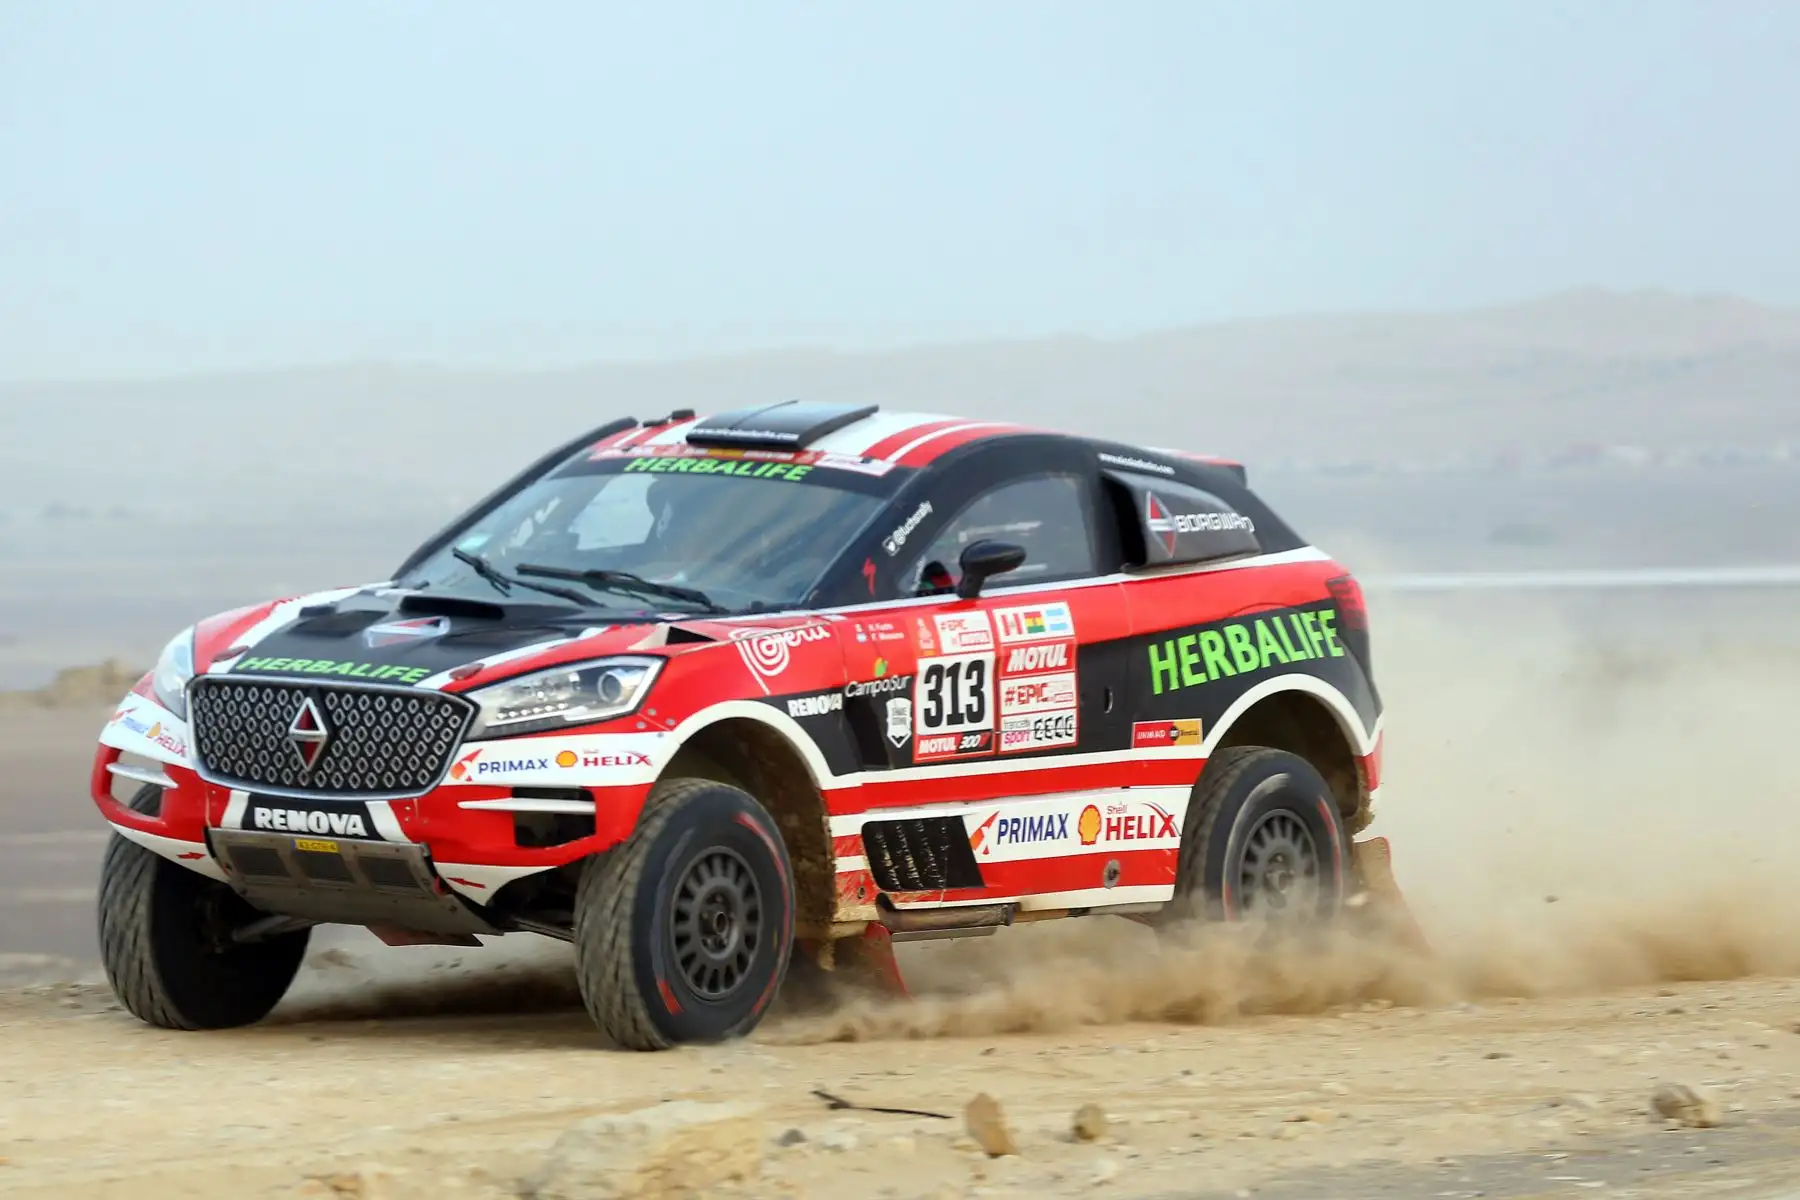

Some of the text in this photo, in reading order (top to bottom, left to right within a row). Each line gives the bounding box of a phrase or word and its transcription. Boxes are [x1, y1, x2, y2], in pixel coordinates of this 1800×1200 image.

[623, 457, 813, 481] HERBALIFE
[1007, 645, 1068, 672] MOTUL
[1148, 609, 1344, 695] HERBALIFE
[236, 657, 430, 683] HERBALIFE
[844, 675, 911, 698] CampoSur
[924, 659, 985, 728] 313
[787, 693, 843, 717] RENOVA
[918, 736, 957, 754] MOTUL
[477, 754, 651, 774] PRIMAX HELIX
[1107, 801, 1128, 815] Shell
[253, 807, 368, 837] RENOVA
[997, 813, 1178, 845] PRIMAX HELIX
